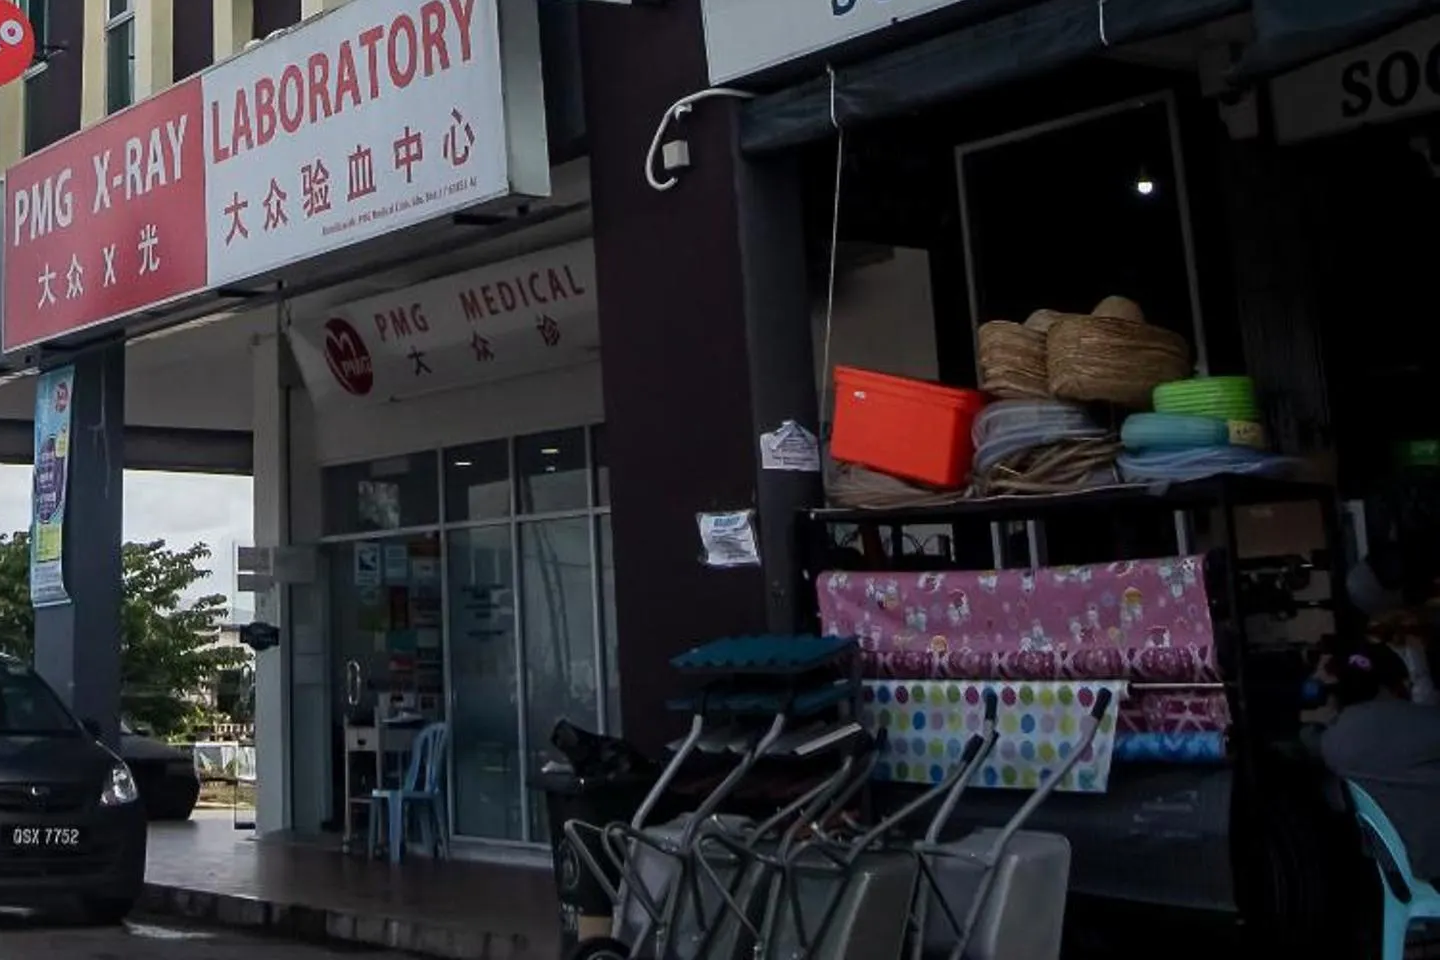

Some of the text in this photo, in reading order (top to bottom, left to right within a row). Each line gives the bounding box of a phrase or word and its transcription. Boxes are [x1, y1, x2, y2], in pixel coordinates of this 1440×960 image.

[13, 112, 189, 247] PMG X-RAY
[223, 107, 476, 246] 大众验血中心
[373, 263, 586, 342] PMG MEDICAL
[45, 827, 80, 845] 7752
